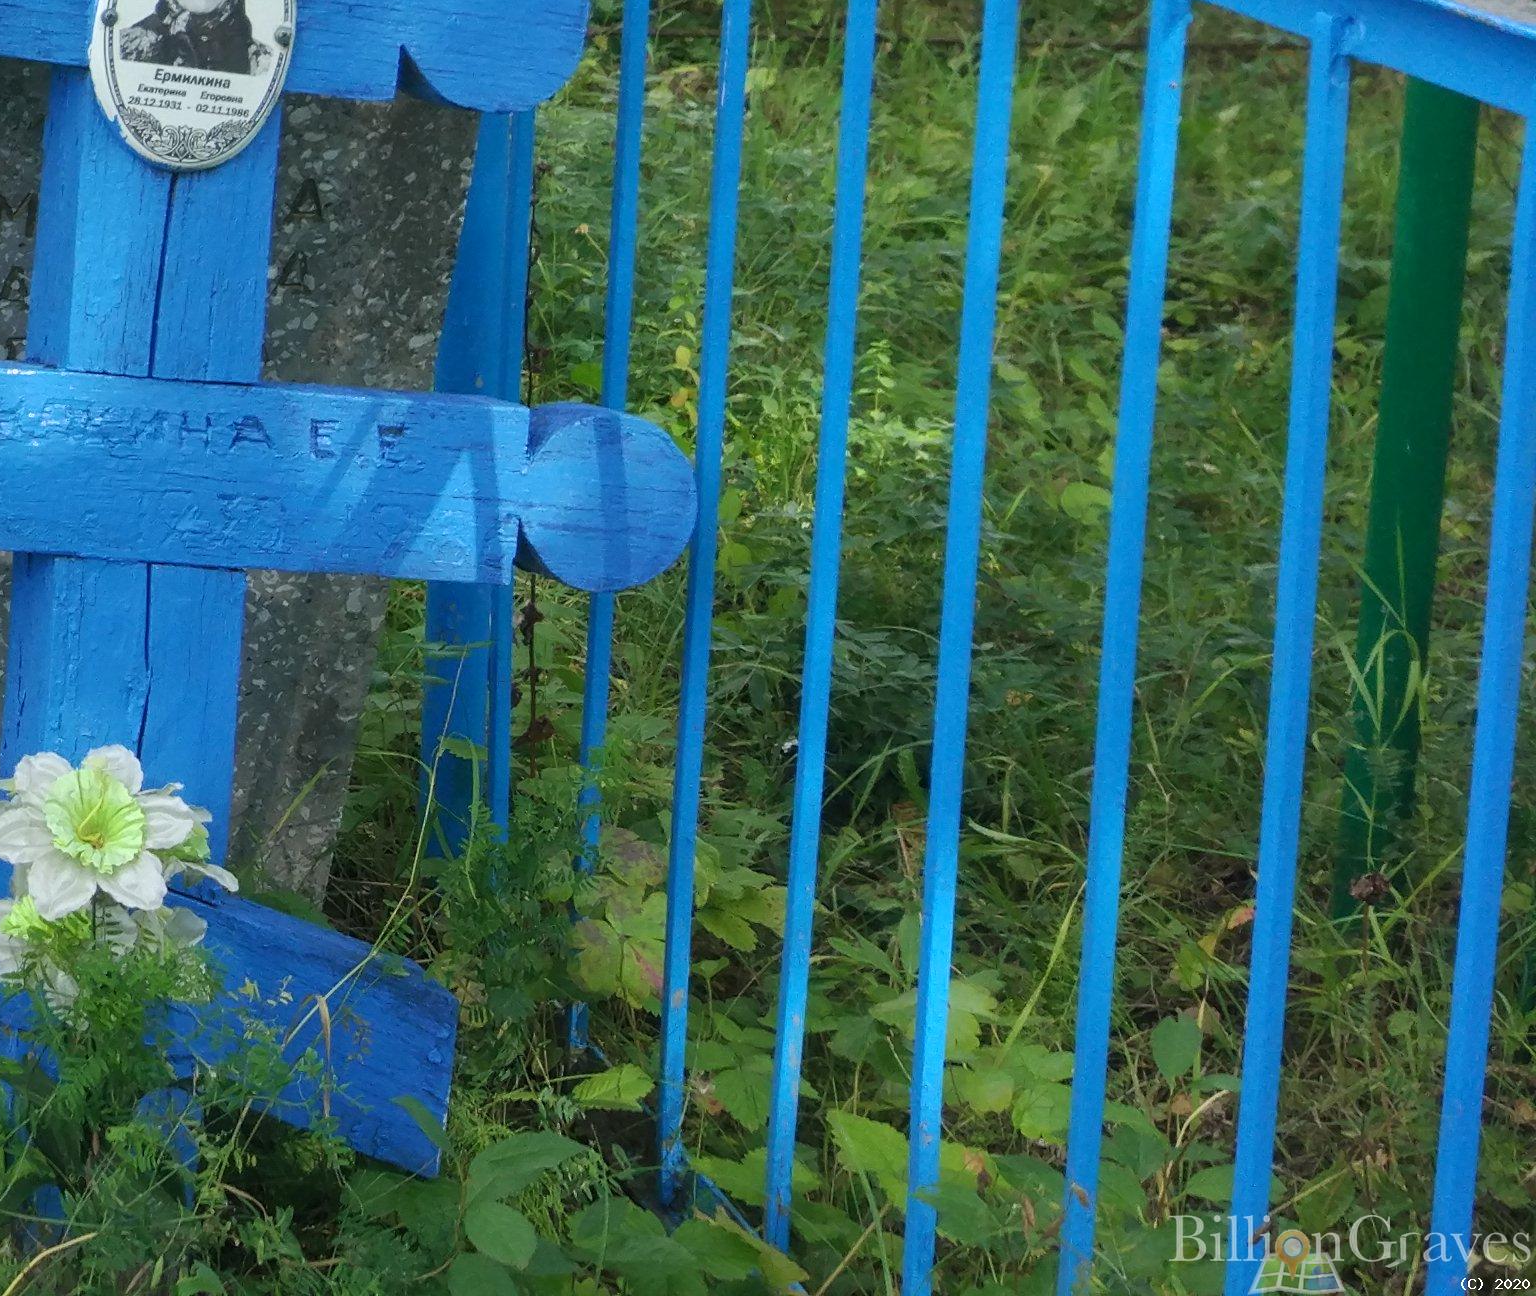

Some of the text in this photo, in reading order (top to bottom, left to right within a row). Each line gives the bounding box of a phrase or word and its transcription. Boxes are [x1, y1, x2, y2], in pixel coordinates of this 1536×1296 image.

[154, 68, 231, 89] Ермилкина
[137, 83, 244, 104] Екатерина Егоровна
